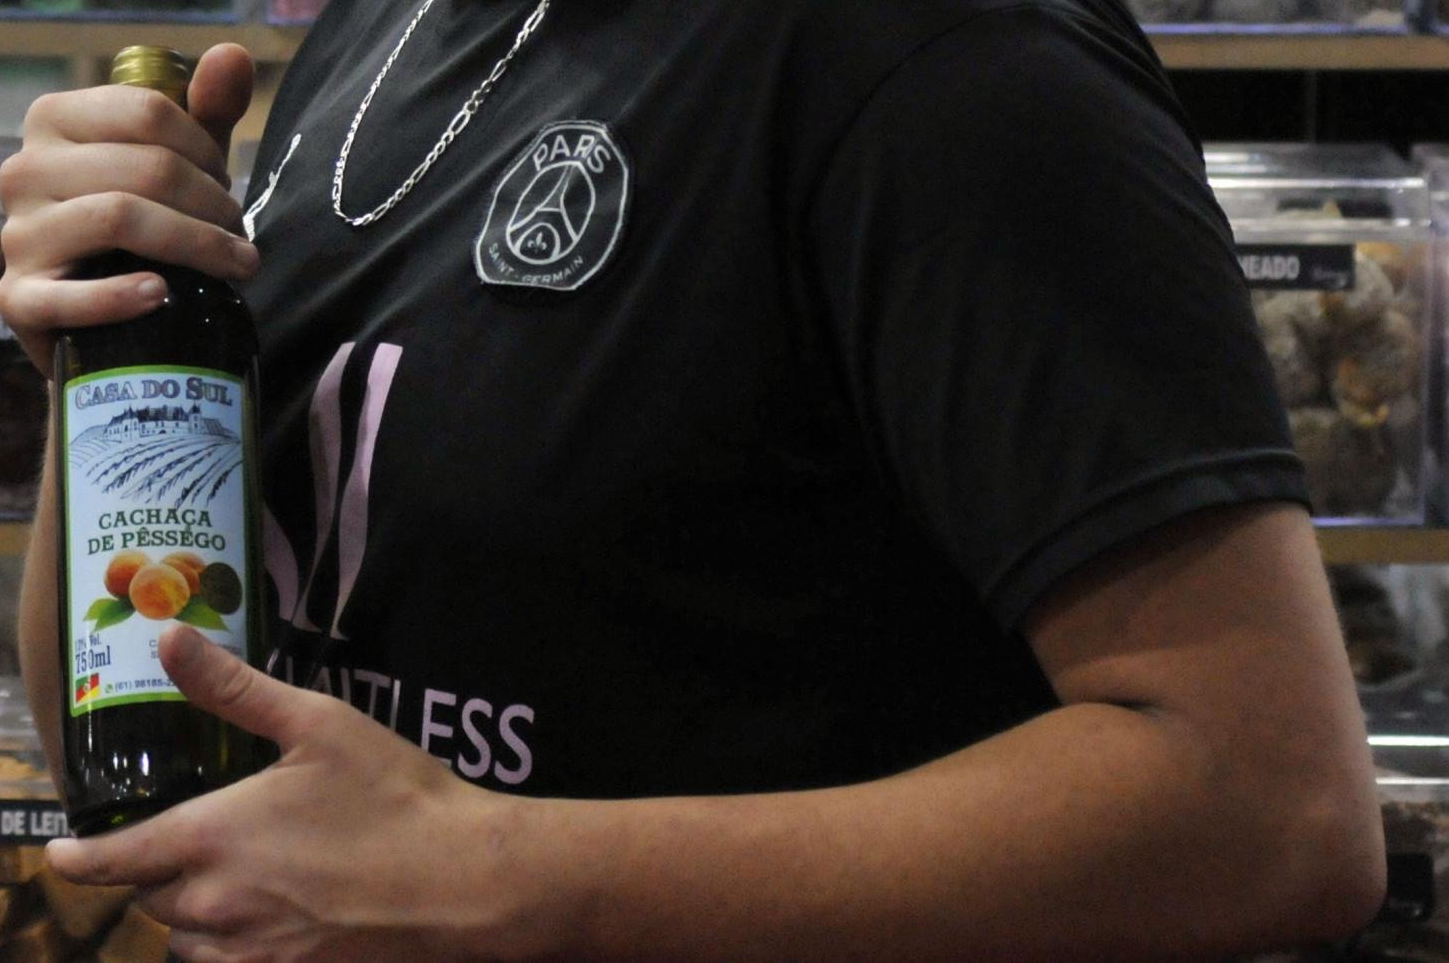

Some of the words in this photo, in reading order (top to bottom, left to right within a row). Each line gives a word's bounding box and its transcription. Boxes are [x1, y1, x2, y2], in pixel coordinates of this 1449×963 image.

[75, 380, 138, 411] CASA
[142, 378, 182, 400] DO
[185, 376, 233, 407] SUL
[98, 508, 213, 534] CACHAÇA
[87, 535, 115, 556] DE
[75, 645, 111, 675] 750ml
[1, 811, 26, 835] DE
[30, 812, 69, 837] LEIT
